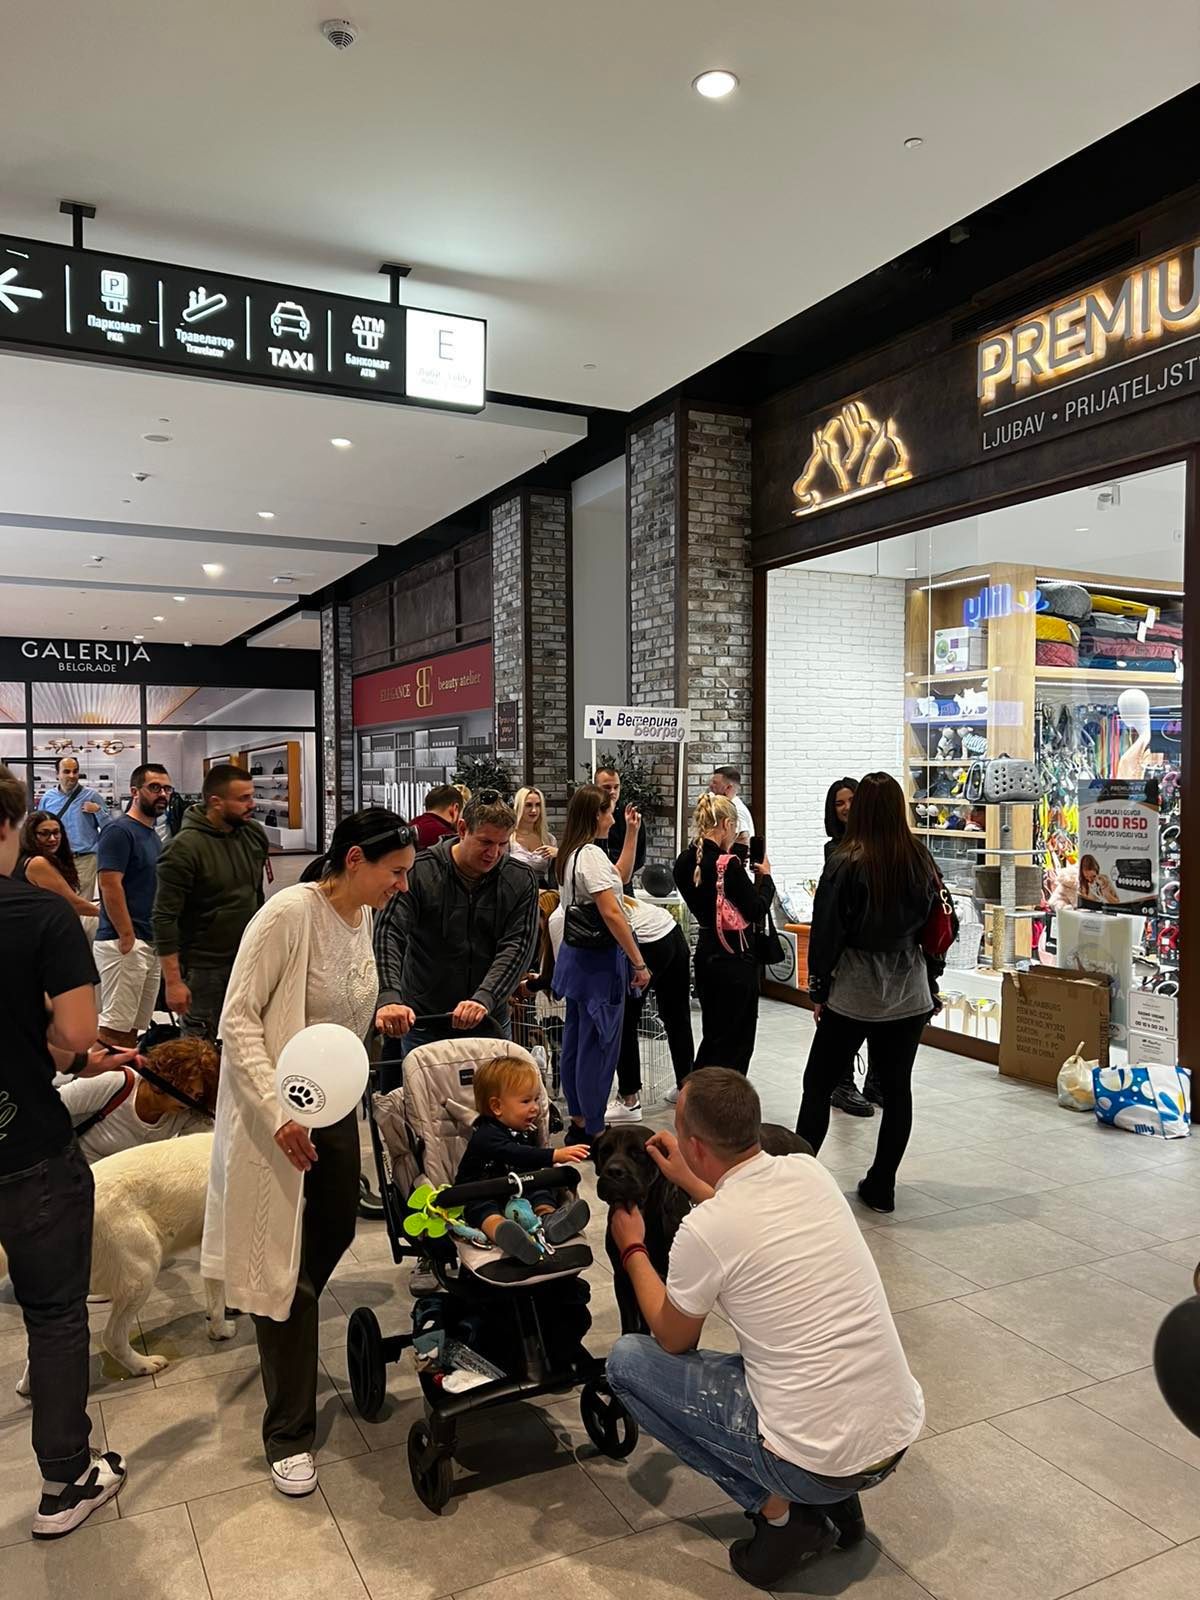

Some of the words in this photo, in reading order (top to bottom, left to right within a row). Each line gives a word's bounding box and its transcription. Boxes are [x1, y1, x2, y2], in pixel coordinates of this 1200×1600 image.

[87, 314, 142, 334] Паркомат
[352, 314, 385, 333] ATM
[175, 328, 235, 350] Травелатор
[438, 329, 454, 361] E
[185, 343, 225, 358] Travelator
[267, 346, 315, 372] TAXI
[345, 352, 391, 371] Банкомат
[359, 367, 377, 379] ATM
[983, 412, 1045, 451] LJUBAV
[1065, 356, 1200, 422] PRIJATELJST
[20, 640, 151, 667] GALERIJA
[58, 662, 117, 673] BELGRADE
[437, 675, 459, 693] beauty
[459, 670, 481, 687] atelier
[616, 713, 678, 728] Ветерина
[634, 722, 686, 742] Београд
[1087, 815, 1119, 829] 1.000
[1123, 817, 1148, 830] RSD
